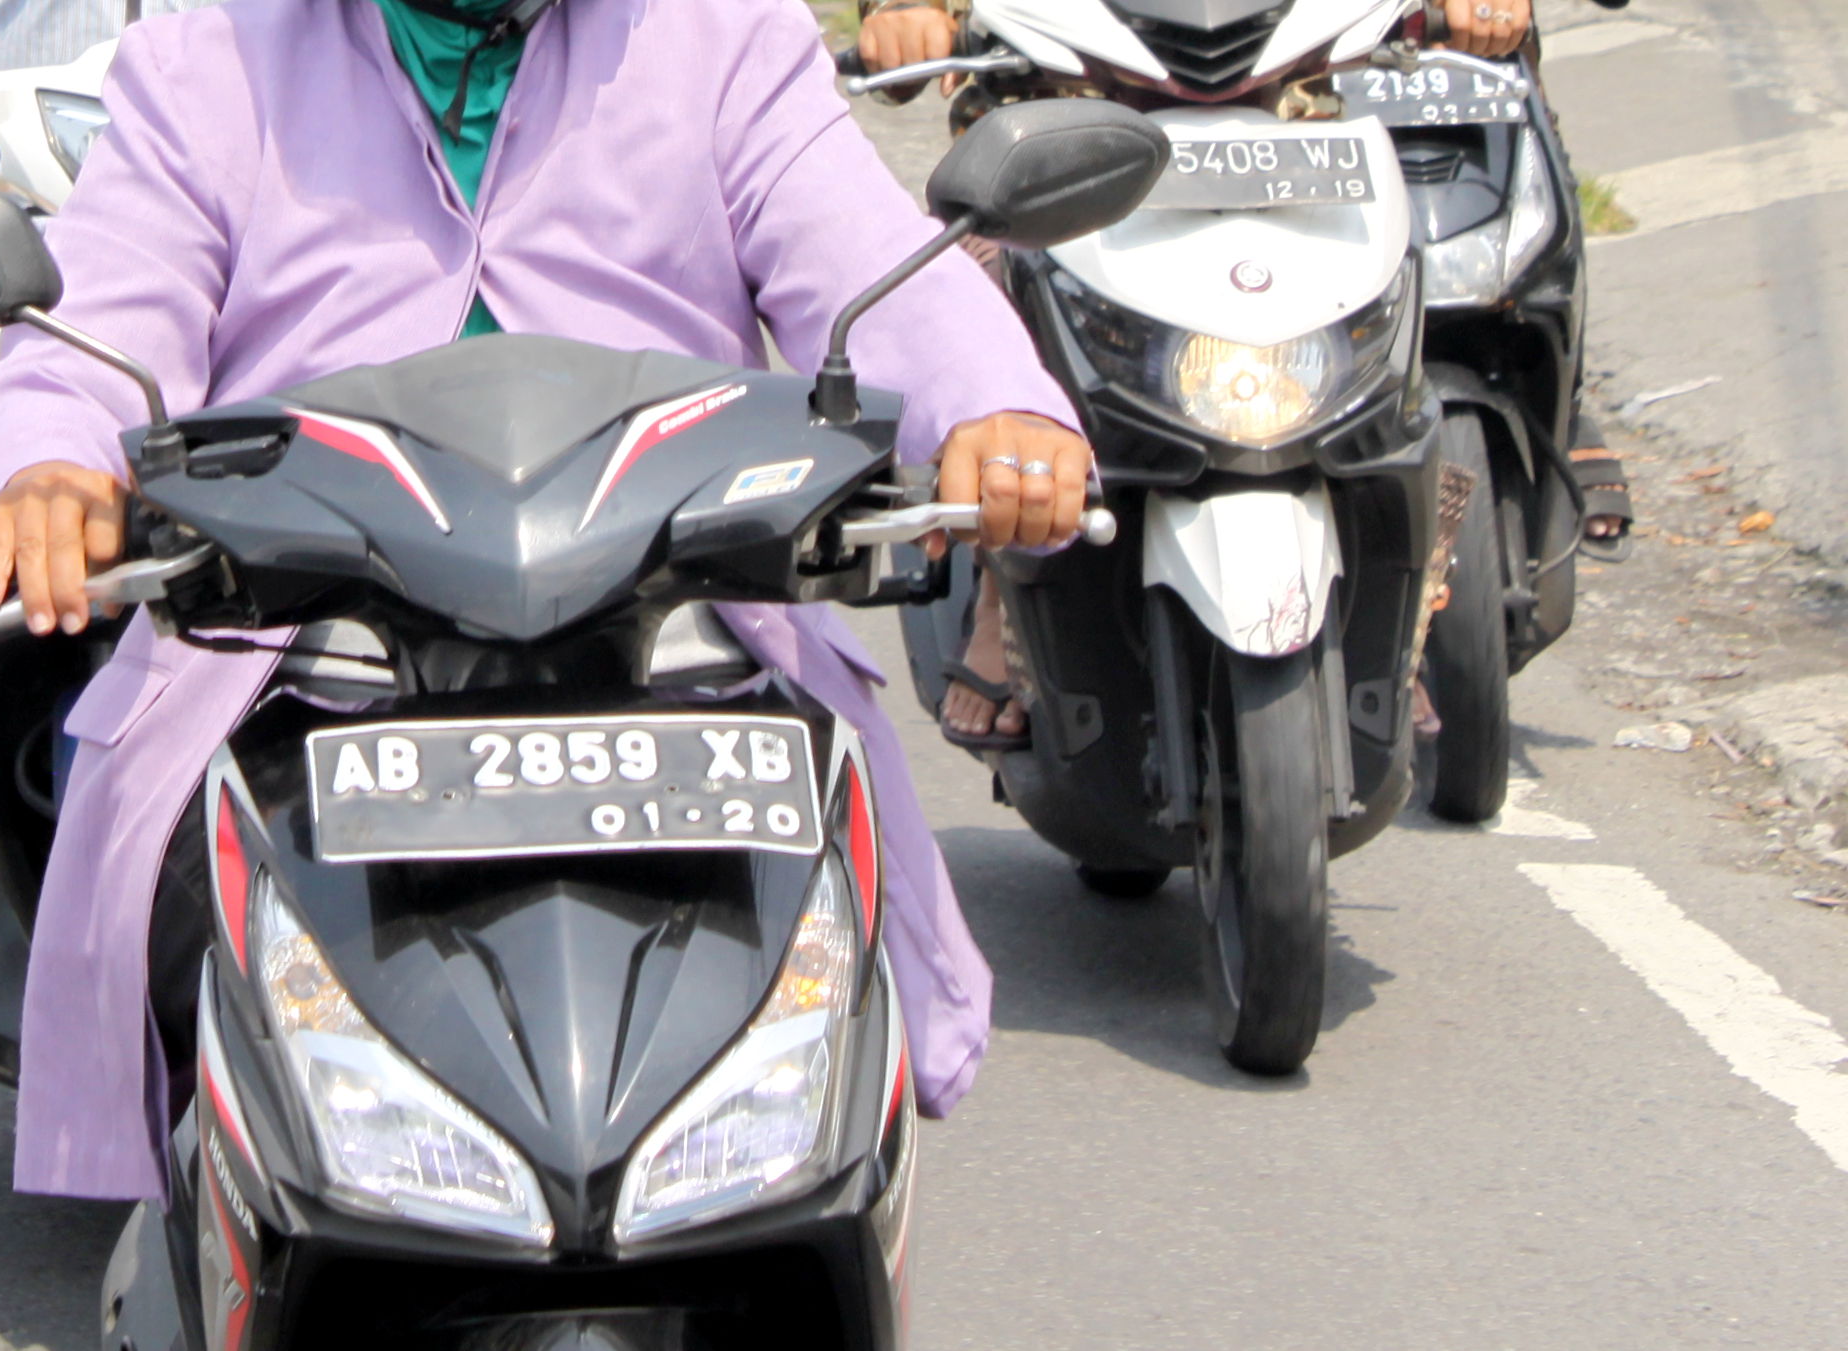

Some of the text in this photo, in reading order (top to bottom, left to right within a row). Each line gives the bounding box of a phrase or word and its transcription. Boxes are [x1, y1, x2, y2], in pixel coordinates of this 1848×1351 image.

[1363, 68, 1449, 98] 2139
[1172, 139, 1359, 174] 5408 WJ
[658, 401, 704, 435] Combi
[332, 729, 792, 793] AB 2859 XB
[209, 1125, 259, 1243] HONDA
